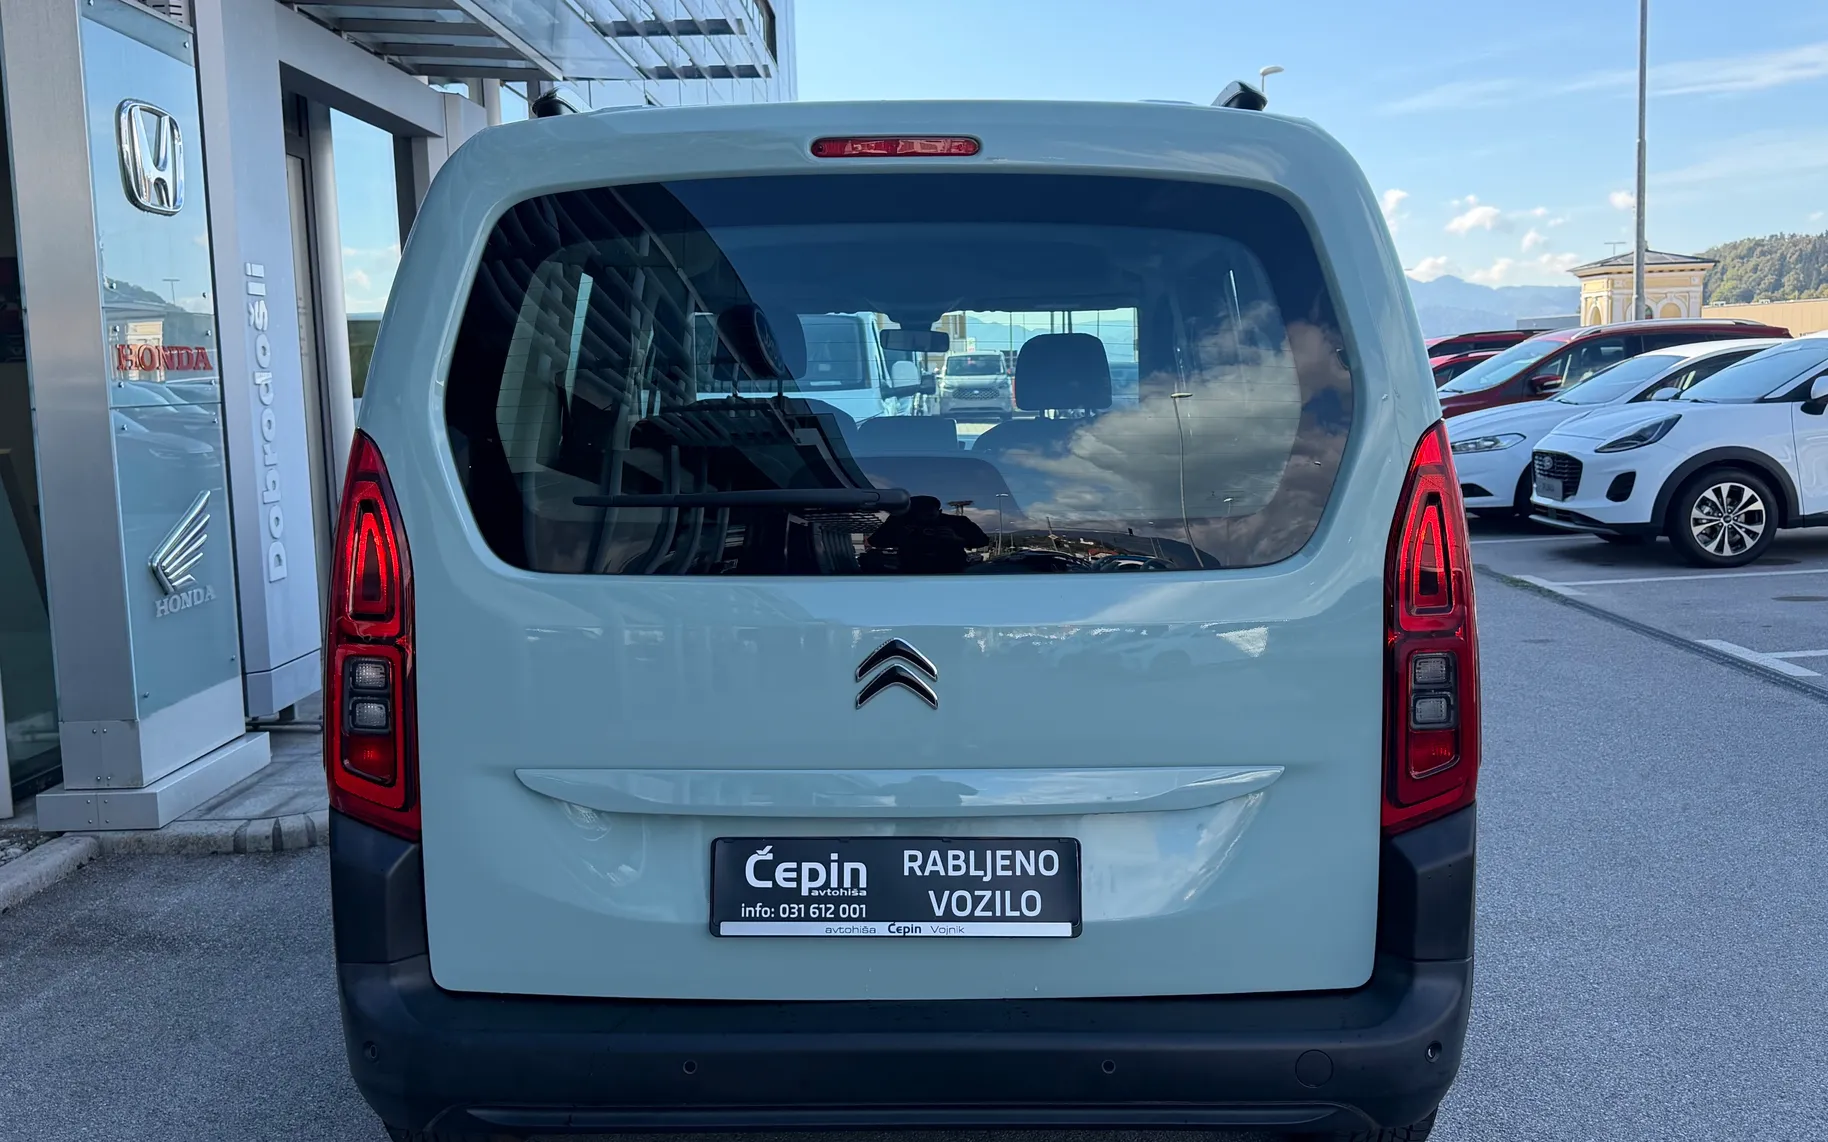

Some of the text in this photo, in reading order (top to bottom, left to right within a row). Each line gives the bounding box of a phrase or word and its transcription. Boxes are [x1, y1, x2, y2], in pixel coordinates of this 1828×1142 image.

[115, 343, 214, 372] HONDA
[245, 261, 288, 583] Dobrodošli
[154, 584, 217, 618] HONDA
[745, 845, 868, 896] Čepin
[903, 849, 1060, 882] RABLJENO
[810, 887, 867, 897] avtohiša
[928, 890, 1042, 918] VOZILO
[741, 903, 867, 918] info: 031 612 001
[825, 922, 965, 937] avtohiša Čepin Vojnik
